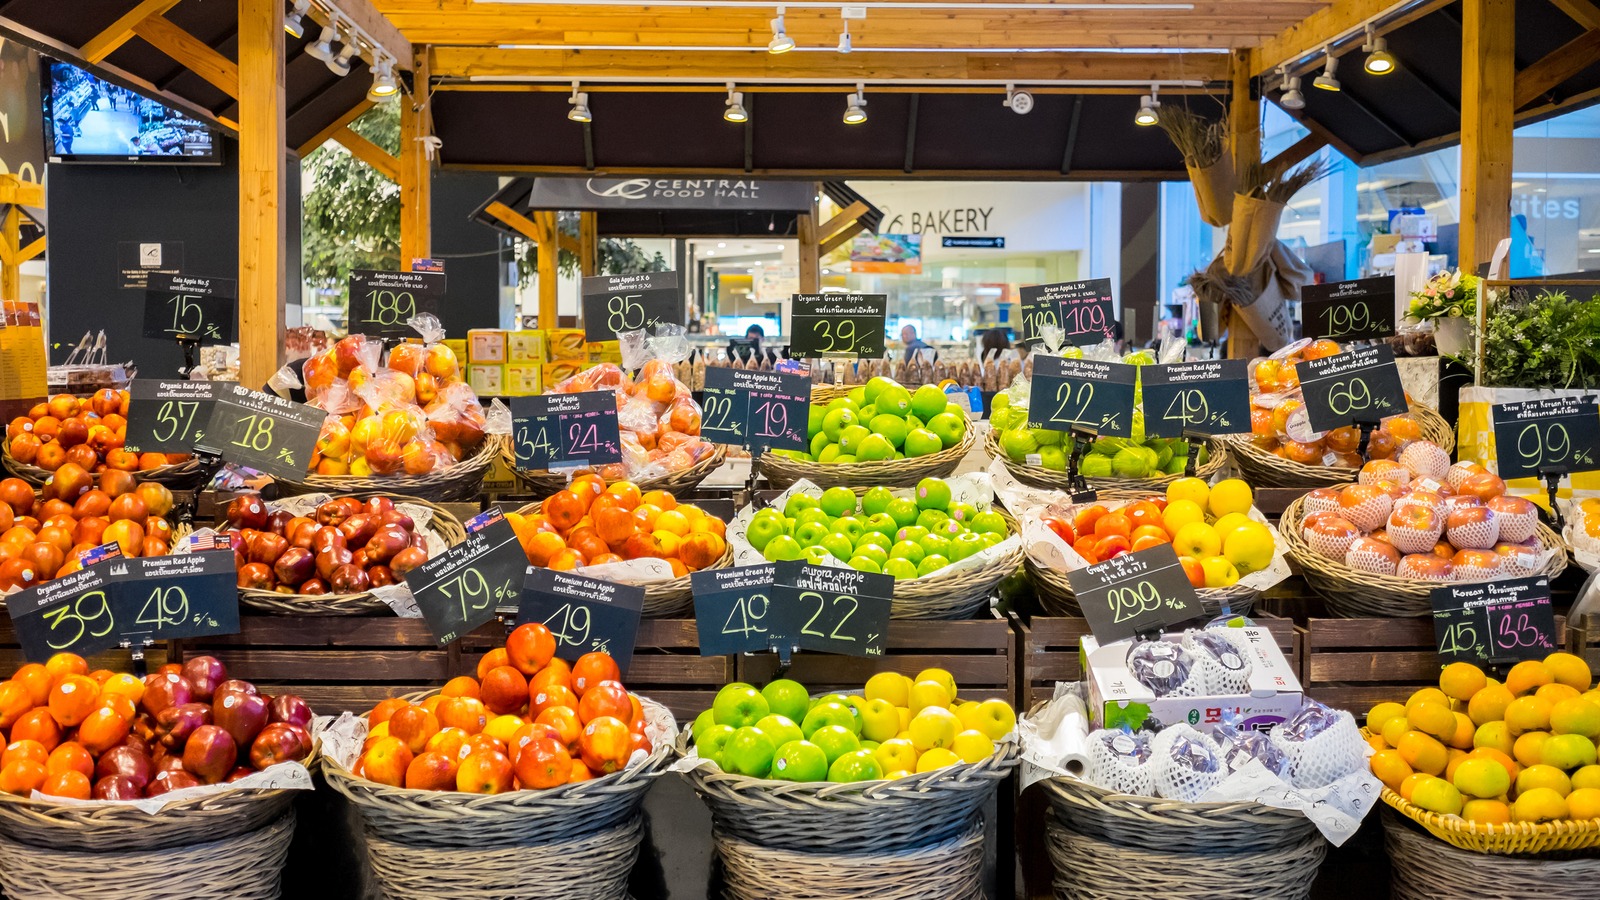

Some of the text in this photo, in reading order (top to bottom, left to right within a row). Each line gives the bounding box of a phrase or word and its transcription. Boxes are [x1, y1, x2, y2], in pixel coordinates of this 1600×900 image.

[653, 189, 759, 199] FOOD HALL
[654, 179, 760, 190] CENTRAL
[911, 206, 994, 235] BAKERY
[183, 278, 197, 286] Apple
[620, 276, 635, 284] Apple
[1338, 282, 1358, 290] Grapple
[163, 294, 203, 334] 15
[361, 289, 416, 326] 189
[607, 294, 645, 333] 85
[798, 294, 820, 304] Organic
[846, 294, 863, 303] Apple
[1065, 304, 1106, 336] 109
[1317, 301, 1370, 339] 199
[813, 319, 855, 353] 39
[1060, 360, 1110, 372] Pacific Rose Apple
[1167, 365, 1192, 373] Premium
[1205, 363, 1222, 371] Apple
[1327, 355, 1350, 365] Korean
[1351, 348, 1379, 360] Premium
[159, 382, 212, 392] Organic Red Apple
[734, 371, 783, 383] Green Apple No.L
[232, 385, 293, 409] RED APPLE NO.L
[548, 395, 578, 405] Envy Apple
[1050, 382, 1098, 426] 22
[1163, 389, 1208, 427] 49
[1329, 377, 1371, 415] 69
[1502, 403, 1519, 412] Snow
[1521, 402, 1537, 410] Pear
[153, 401, 199, 442] 37
[701, 396, 732, 431] 22
[754, 401, 788, 438] 19
[231, 415, 274, 451] 18
[514, 426, 551, 461] 34
[567, 422, 604, 455] 24
[1517, 422, 1571, 469] 99
[472, 524, 484, 533] New
[86, 549, 121, 566] New Zealand
[215, 542, 230, 550] USA
[421, 533, 486, 573] Premium Envy Apple
[142, 556, 206, 568] Premium Red Apple
[716, 569, 763, 580] Premium Green
[801, 566, 832, 579] Aurora
[1086, 564, 1110, 576] Grape
[1109, 558, 1125, 572] Kyo
[37, 570, 96, 597] Organic Gala Apple
[438, 567, 490, 622] 79
[554, 574, 616, 594] Premium Gala Apple
[1452, 583, 1529, 598] Korean Persimmon
[135, 585, 189, 630] 49
[799, 591, 858, 641] 22
[1107, 580, 1162, 624] 299
[42, 590, 114, 650] 39
[542, 603, 591, 646] 49
[1497, 613, 1539, 649] 33
[1438, 621, 1477, 656] 45
